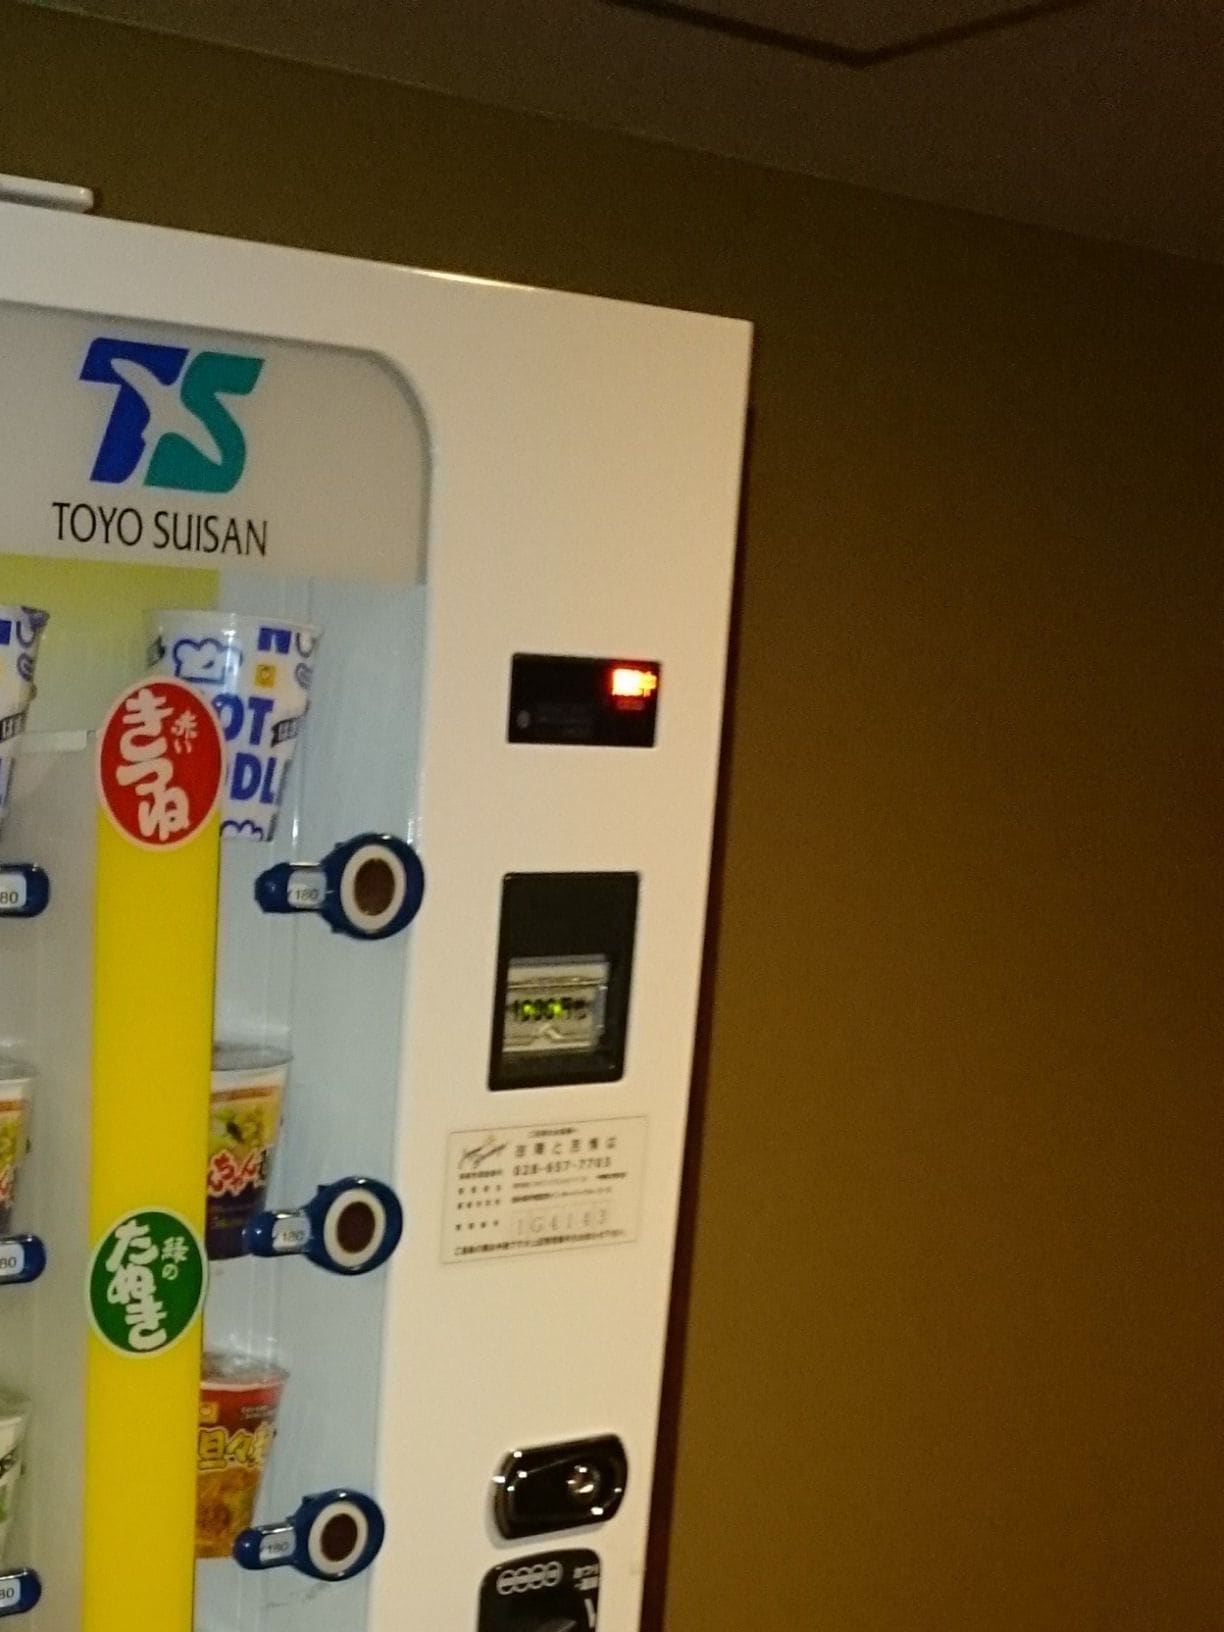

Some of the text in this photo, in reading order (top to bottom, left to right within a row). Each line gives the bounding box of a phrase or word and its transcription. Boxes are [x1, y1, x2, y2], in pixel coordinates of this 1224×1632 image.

[52, 502, 268, 557] TOYO SUISAN
[116, 688, 191, 842] きつね
[211, 693, 276, 746] OT
[105, 1219, 168, 1350] たぬき
